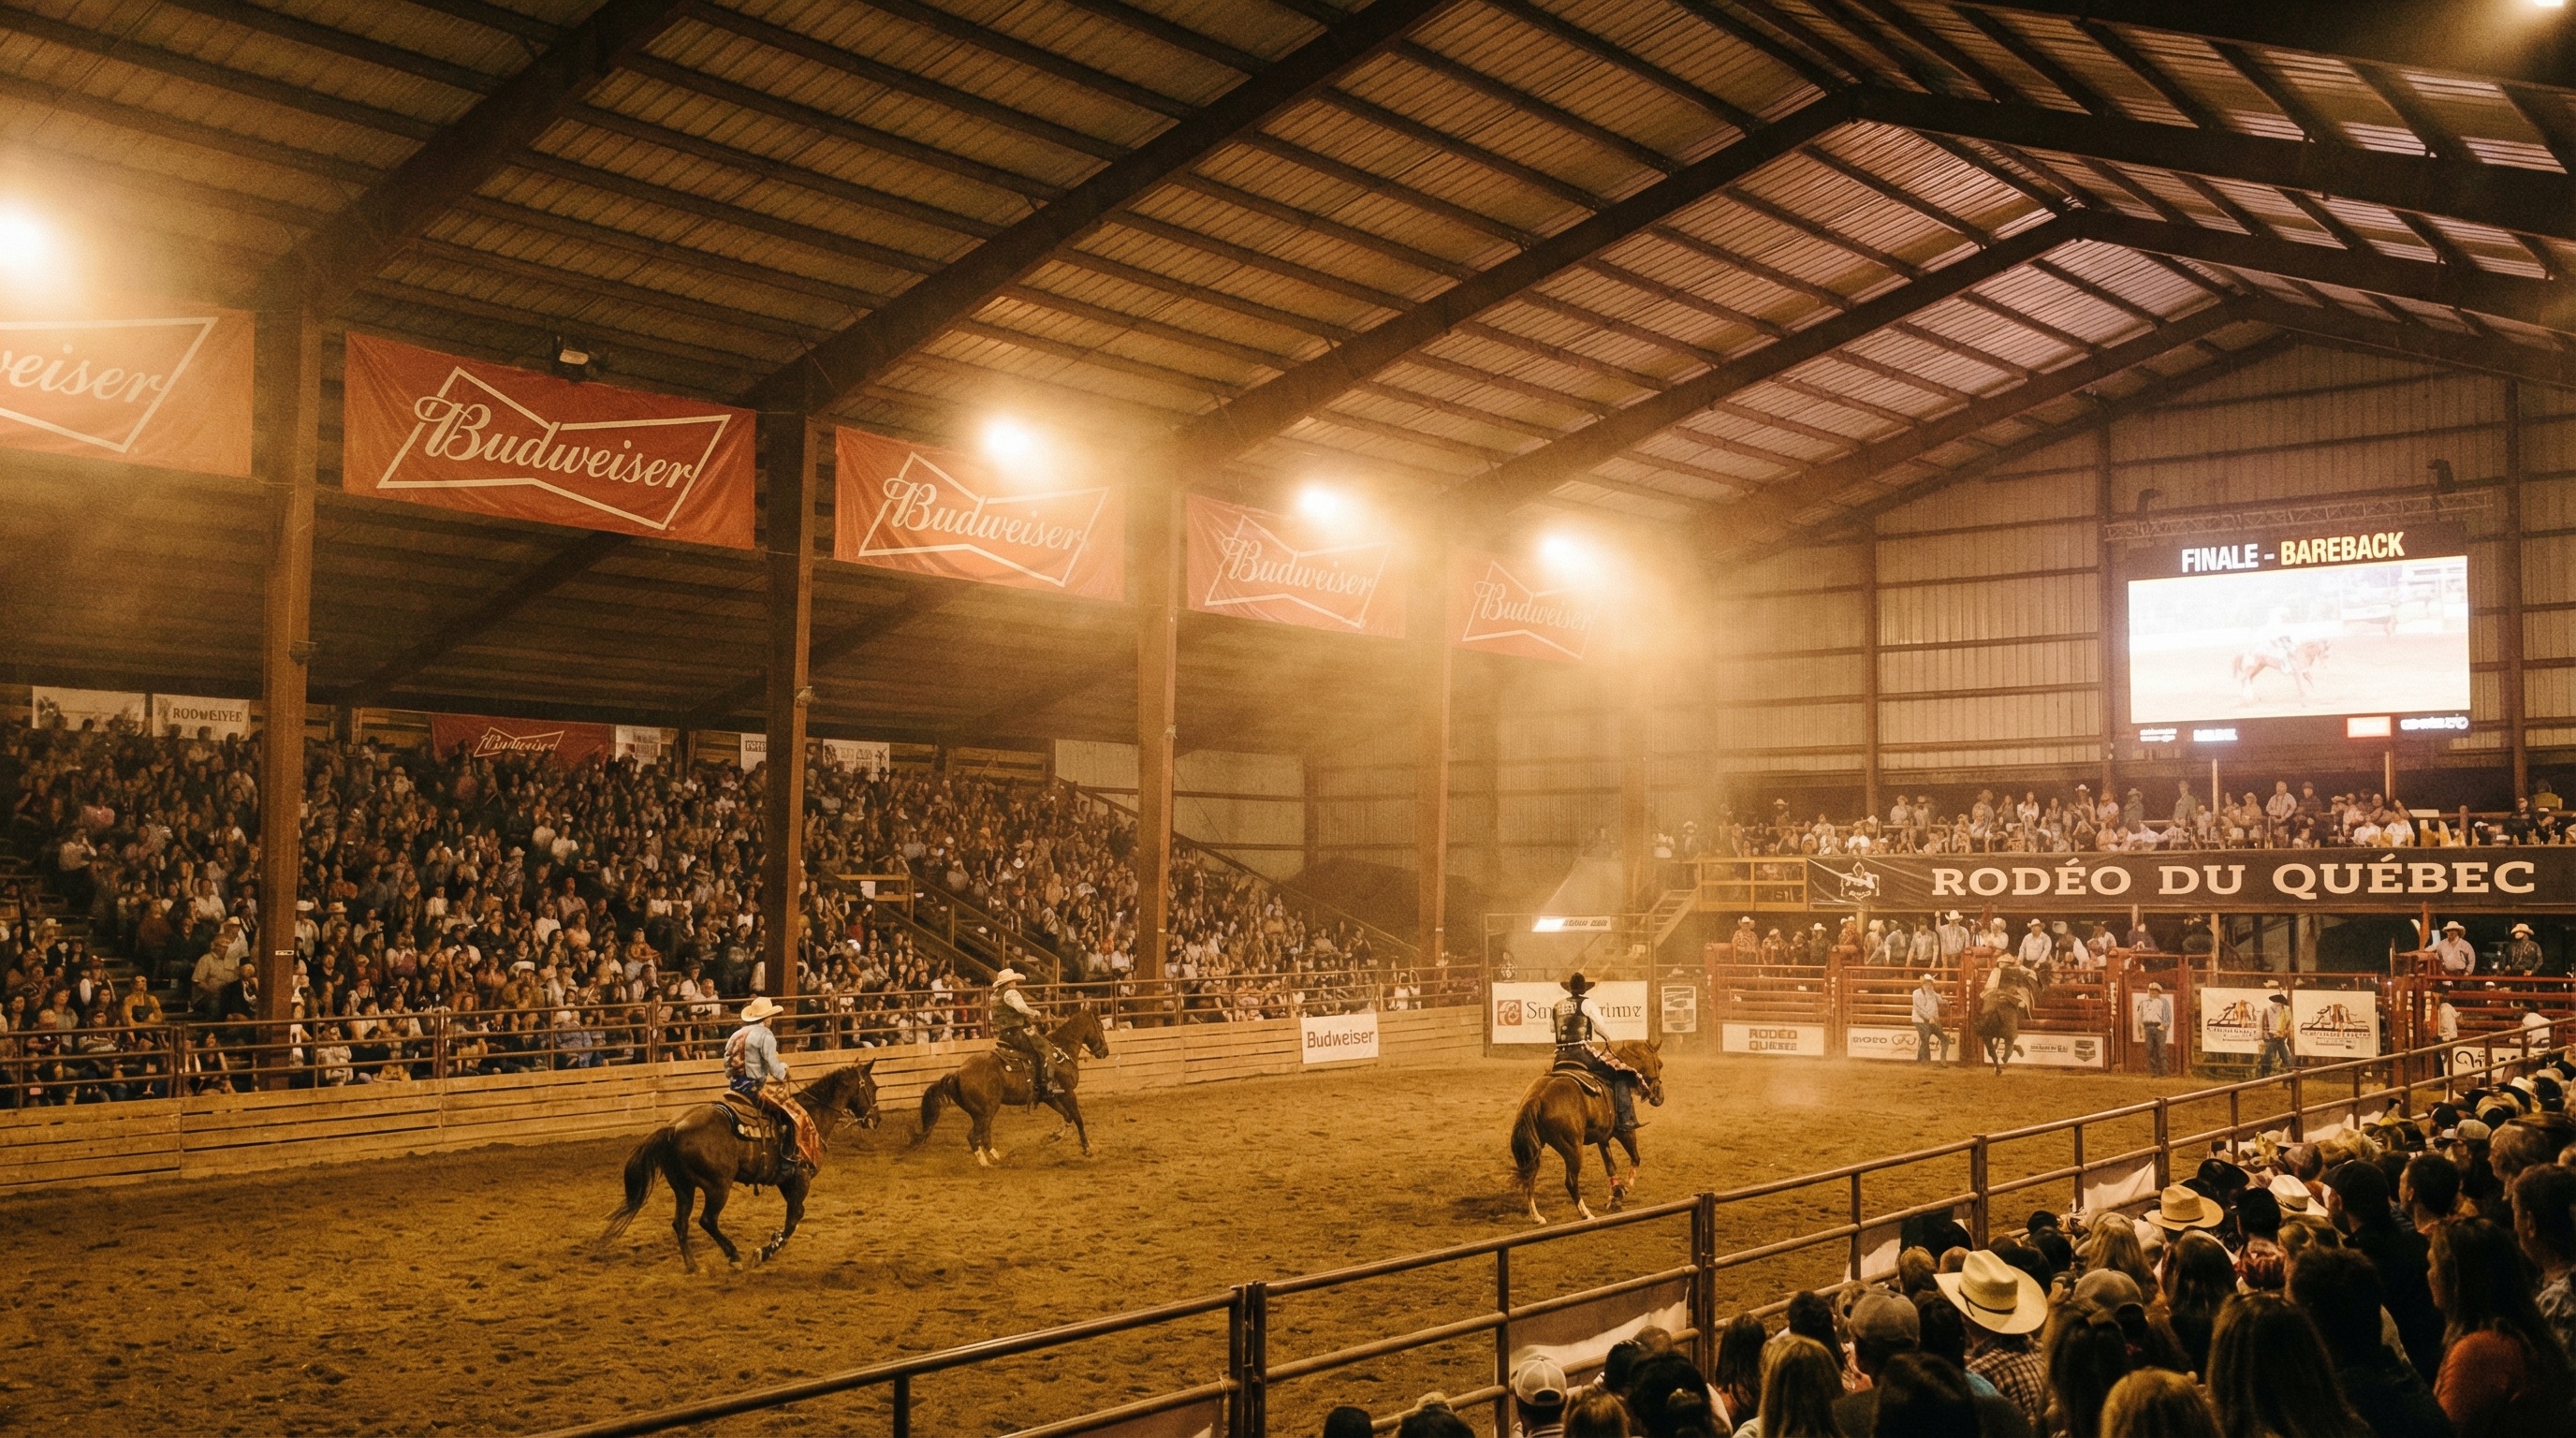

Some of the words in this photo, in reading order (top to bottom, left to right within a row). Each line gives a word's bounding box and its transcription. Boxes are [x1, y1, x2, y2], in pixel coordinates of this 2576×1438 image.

[414, 395, 694, 488] Budweiser
[883, 477, 1084, 550] Budweiser
[1221, 536, 1374, 596] Budweiser
[2181, 543, 2259, 574] FINALE
[2280, 531, 2406, 566] BAREBACK
[1473, 580, 1593, 632] Budweiser
[1931, 857, 2132, 896] RODÉO
[2158, 864, 2246, 895] DU
[2272, 852, 2536, 900] QUÉBEC
[1307, 1030, 1374, 1049] Budweiser
